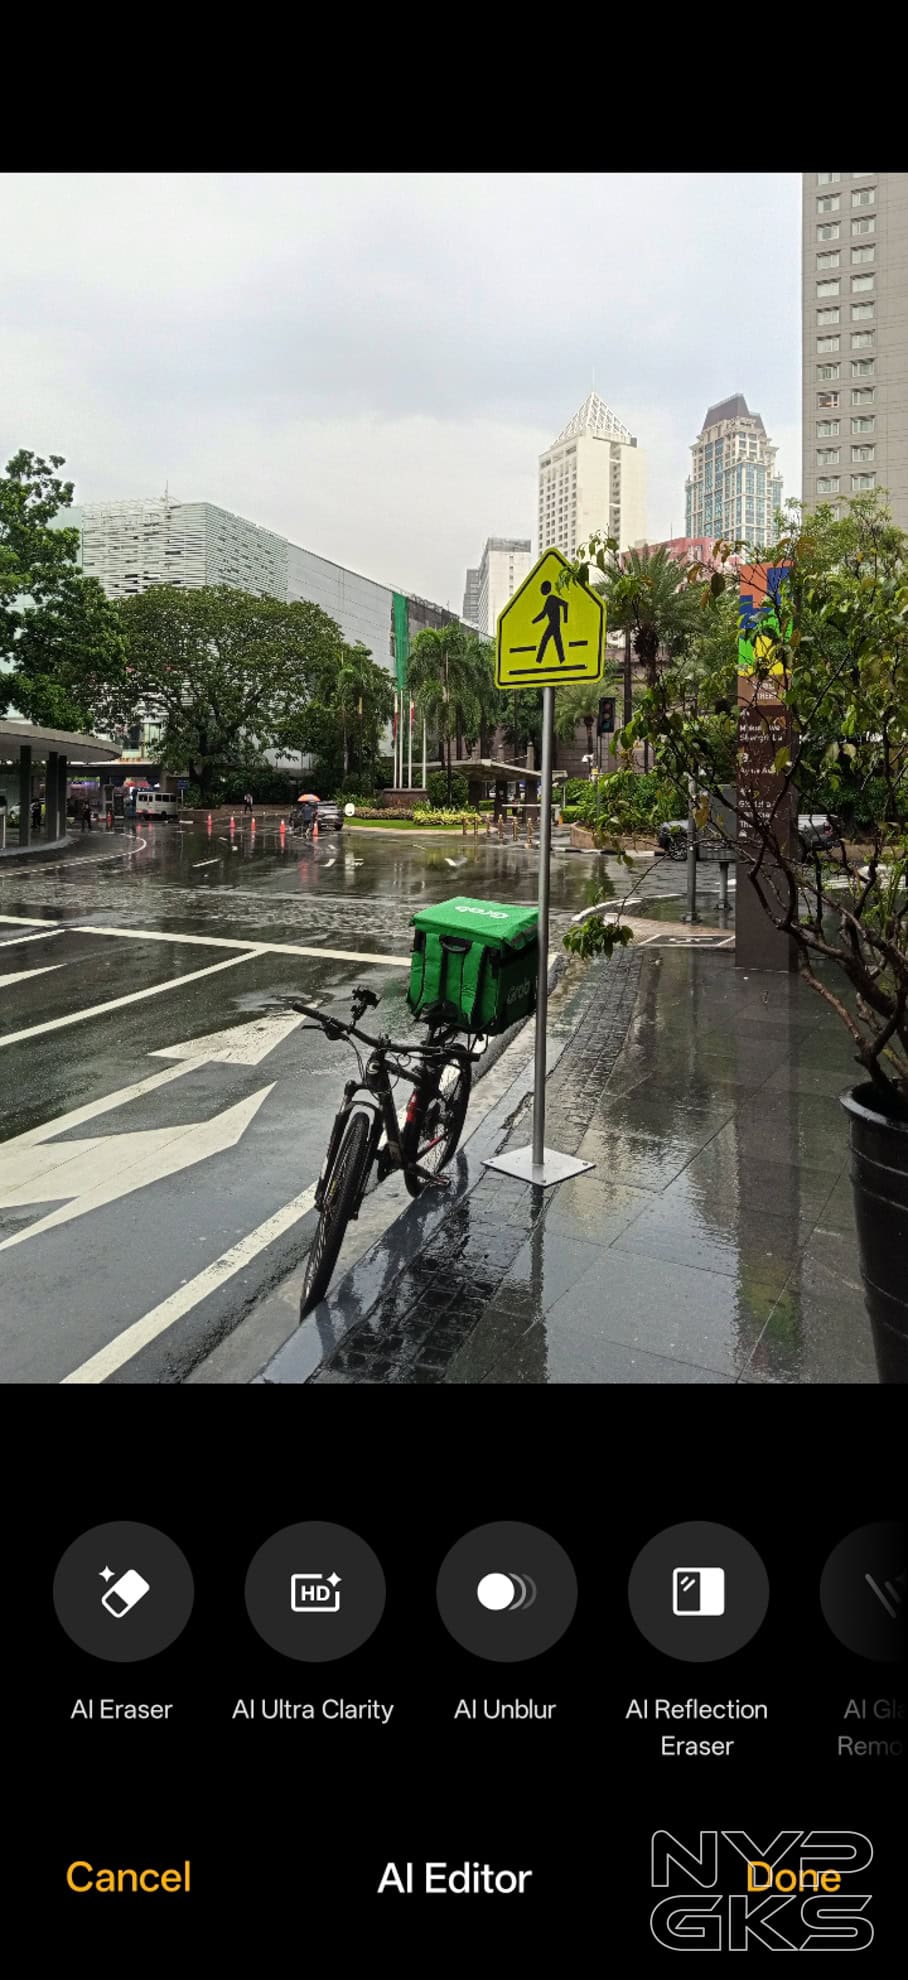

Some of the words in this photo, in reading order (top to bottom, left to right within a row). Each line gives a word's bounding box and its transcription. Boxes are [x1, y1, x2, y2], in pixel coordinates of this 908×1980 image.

[301, 1584, 331, 1602] HD
[70, 1698, 93, 1720] AI
[101, 1698, 174, 1720] Eraser
[231, 1698, 255, 1720] AI
[262, 1698, 315, 1720] Ultra
[321, 1698, 395, 1725] Clarity
[453, 1698, 477, 1720] AI
[484, 1698, 557, 1720] Unblur
[625, 1698, 648, 1720] AI
[655, 1697, 768, 1720] Reflection
[843, 1698, 866, 1720] AI
[661, 1735, 735, 1756] Eraser
[65, 1859, 191, 1893] Cancel
[376, 1861, 414, 1894] AI
[425, 1860, 534, 1894] Editor
[747, 1860, 842, 1893] Done
